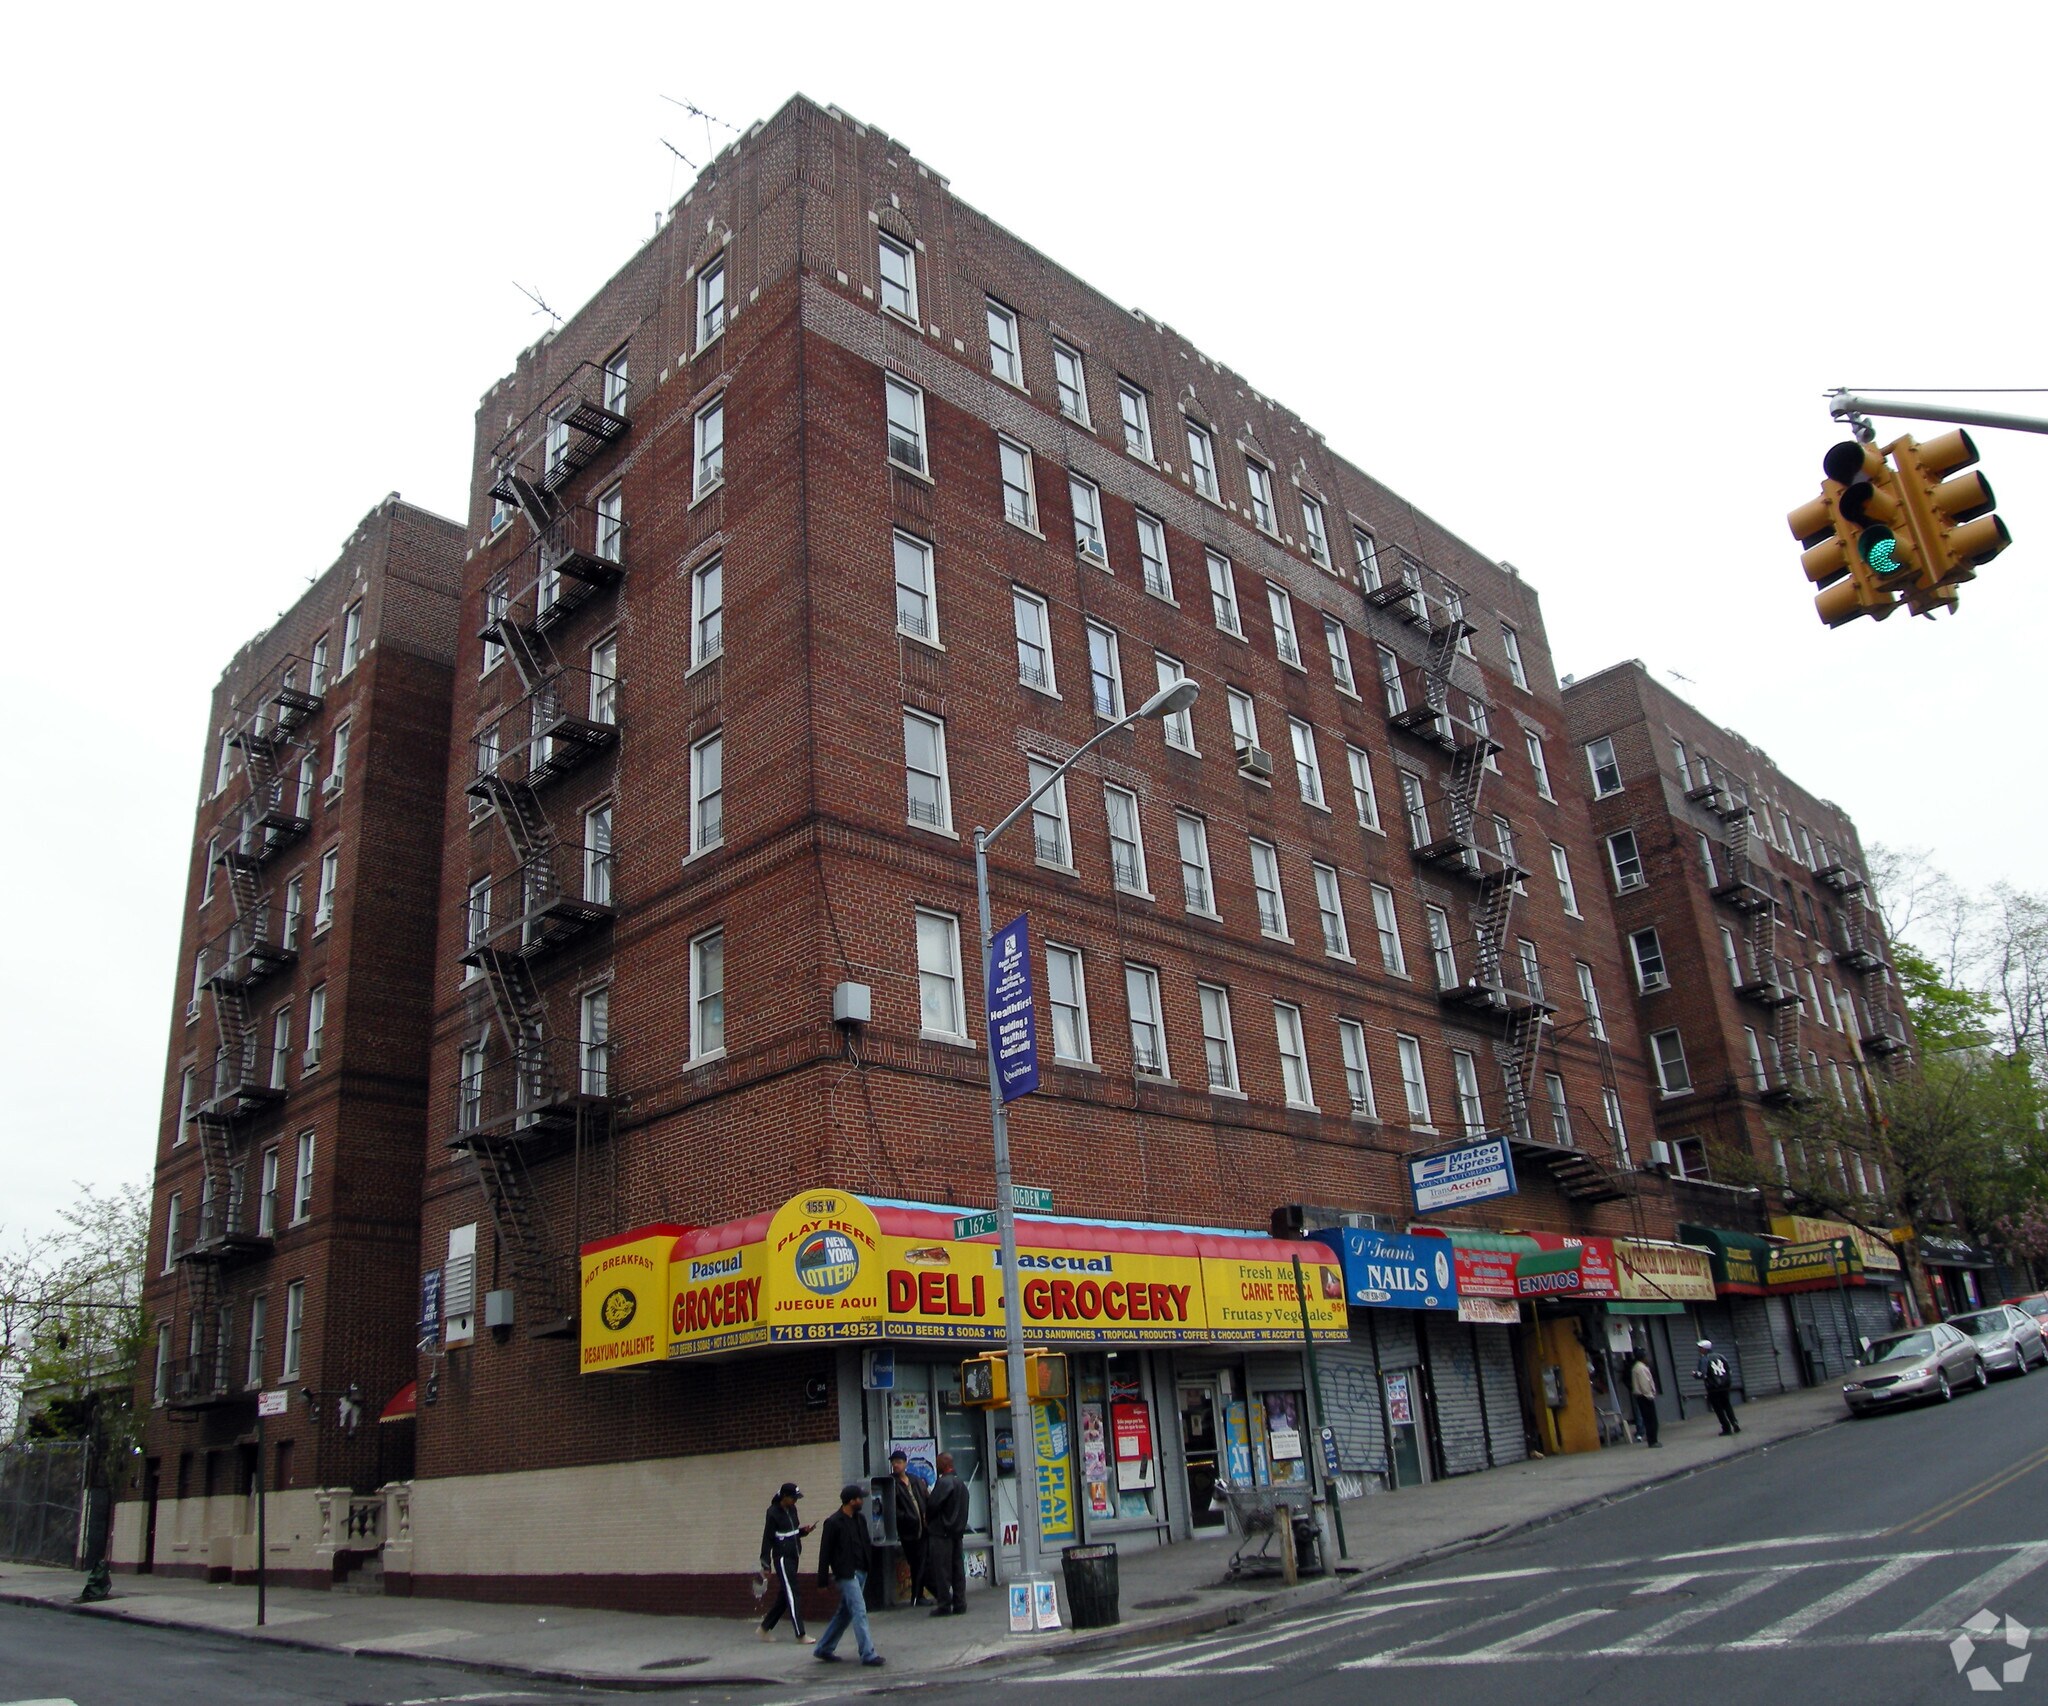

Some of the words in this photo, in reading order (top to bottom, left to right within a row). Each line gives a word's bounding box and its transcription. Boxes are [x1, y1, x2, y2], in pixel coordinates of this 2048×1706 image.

[990, 996, 1032, 1021] Healthfirst
[999, 1020, 1024, 1036] Building
[1024, 1017, 1029, 1025] a
[1001, 1029, 1028, 1047] Healthier
[1000, 1040, 1031, 1060] Community
[1449, 1146, 1499, 1163] Mateo
[1449, 1154, 1499, 1173] Express
[1418, 1179, 1447, 1189] AGENTE
[1450, 1164, 1501, 1181] AUTORIZADO
[1014, 1188, 1040, 1207] OGDEN
[1041, 1192, 1050, 1201] AV
[957, 1221, 965, 1237] W
[969, 1217, 985, 1235] 162
[987, 1213, 996, 1223] ST
[777, 1220, 822, 1252] PLAY
[828, 1220, 876, 1252] HERE
[826, 1237, 847, 1248] NEW
[691, 1250, 743, 1279] Pascual
[827, 1247, 854, 1264] YORK
[585, 1265, 600, 1288] HOT
[602, 1254, 654, 1272] BREAKFAST
[802, 1262, 857, 1287] LOTTERY
[1239, 1266, 1272, 1279] Fresh
[1367, 1264, 1429, 1292] NAILS
[1241, 1282, 1274, 1301] CARNE
[1519, 1271, 1579, 1293] ENVIOS
[774, 1299, 835, 1311] JUEGUE
[840, 1297, 877, 1308] AQUI
[887, 1269, 985, 1317] DELI
[1024, 1279, 1191, 1321] GROCERY
[672, 1276, 762, 1336] GROCERY
[1223, 1307, 1263, 1321] Frutas
[1265, 1312, 1272, 1323] y
[1274, 1309, 1333, 1323] Vegeales
[1331, 1303, 1345, 1313] 951
[680, 1342, 693, 1354] BEERS
[693, 1342, 697, 1352] &
[697, 1339, 710, 1351] SODAS
[713, 1337, 723, 1349] HOT
[723, 1336, 727, 1347] &
[727, 1333, 738, 1345] COLD
[739, 1328, 767, 1343] SANDWICHES
[776, 1326, 803, 1340] 718
[808, 1323, 878, 1338] 681-4952
[888, 1324, 913, 1335] COLD
[915, 1325, 945, 1336] BEERS
[948, 1326, 954, 1336] &
[957, 1327, 985, 1338] SODAS
[993, 1329, 1006, 1339] HO
[1022, 1329, 1043, 1339] COLD
[1045, 1330, 1096, 1340] SANDWICHES
[1102, 1330, 1138, 1340] TROPICAL
[1139, 1330, 1177, 1340] PRODUCTS
[1182, 1330, 1208, 1340] COFFEE
[1210, 1331, 1216, 1339] &
[1217, 1331, 1256, 1339] CHOCOLATE
[1261, 1331, 1270, 1339] WE
[1272, 1331, 1295, 1339] ACCEPT
[1296, 1331, 1305, 1339] EB
[1312, 1331, 1324, 1339] WIC
[1324, 1331, 1349, 1339] CHECKS
[584, 1345, 619, 1365] DESAYUNO
[620, 1335, 655, 1358] CALIENTE
[875, 1363, 892, 1373] Phone
[894, 1443, 933, 1455] Pregnant?
[1051, 1429, 1064, 1455] YORK
[1038, 1465, 1053, 1529] HERE
[1051, 1466, 1068, 1525] PLAY
[1003, 1524, 1020, 1546] AT
